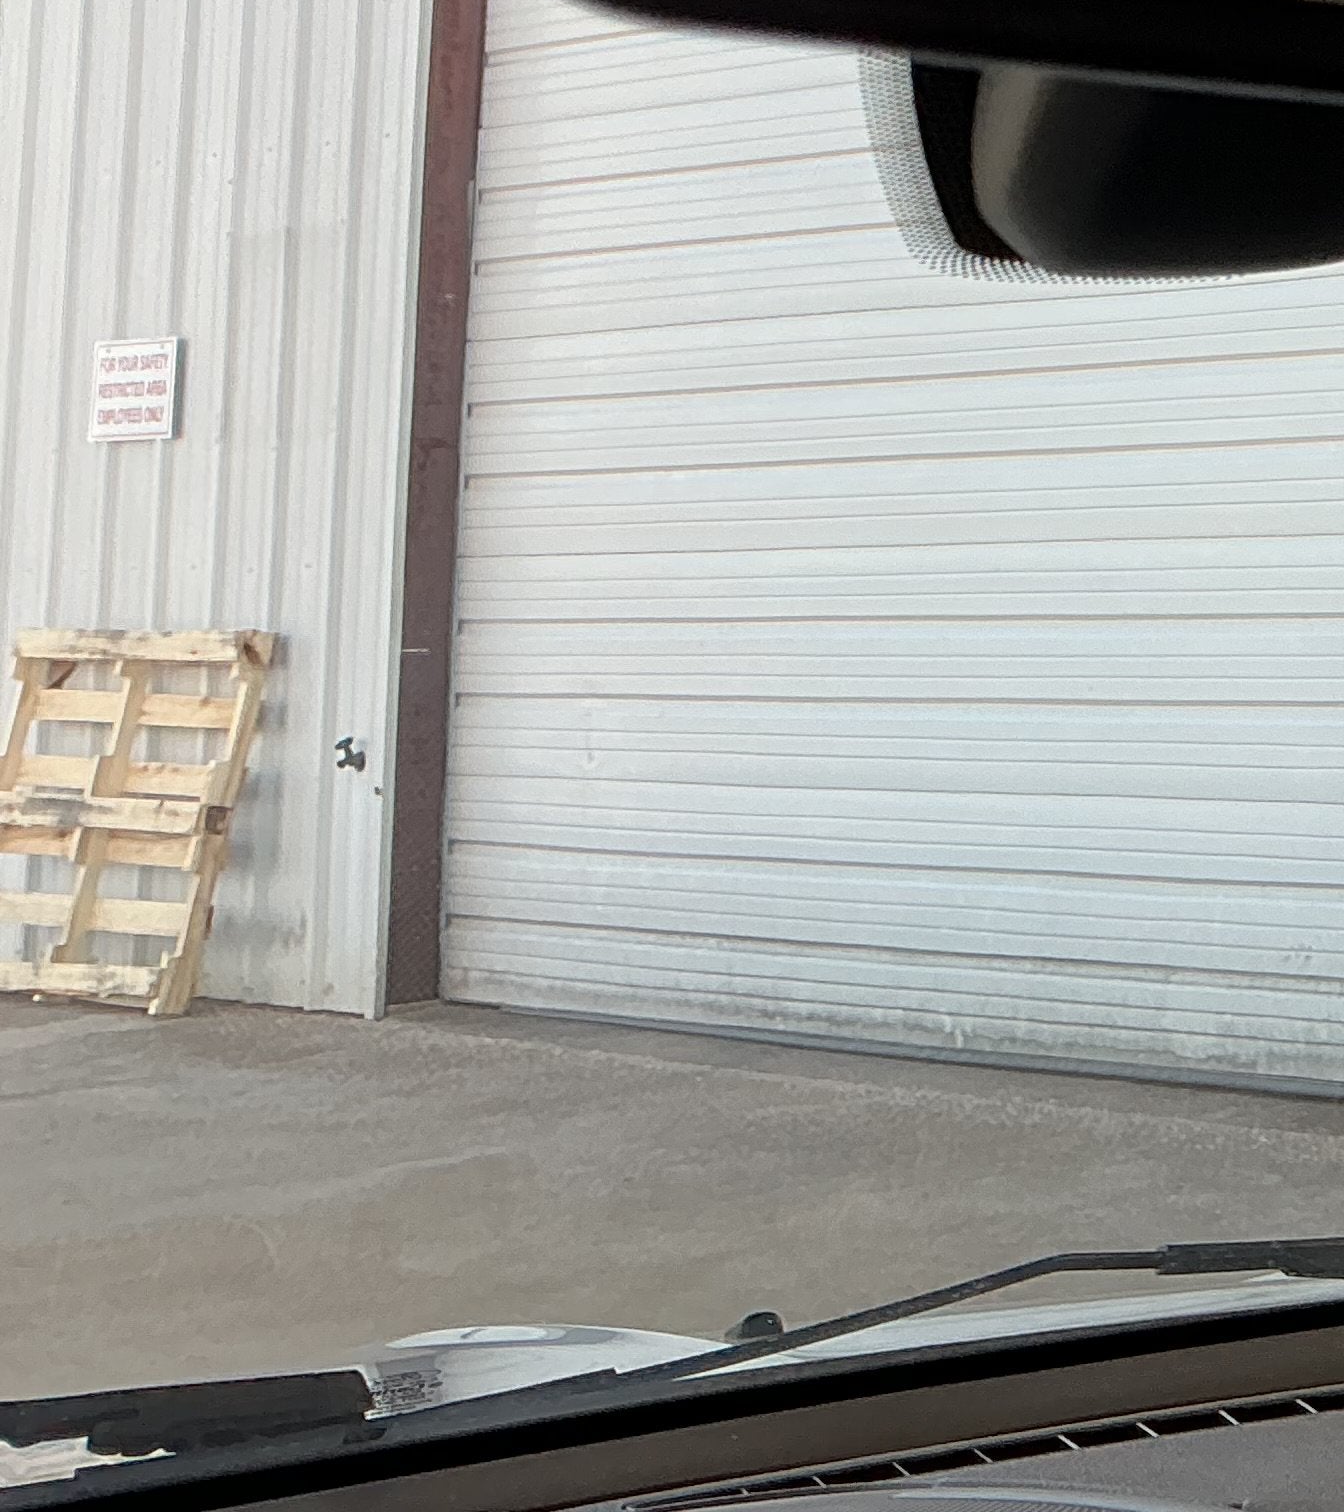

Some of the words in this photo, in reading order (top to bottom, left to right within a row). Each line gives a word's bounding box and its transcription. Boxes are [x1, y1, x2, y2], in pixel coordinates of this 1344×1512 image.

[100, 357, 117, 372] FOR
[118, 355, 139, 372] YOUR
[140, 353, 169, 371] SAFETY
[98, 381, 146, 398] RESTRICTED
[146, 379, 167, 396] AREA
[97, 408, 143, 425] EMPLOYEES
[144, 406, 164, 423] ONLY
